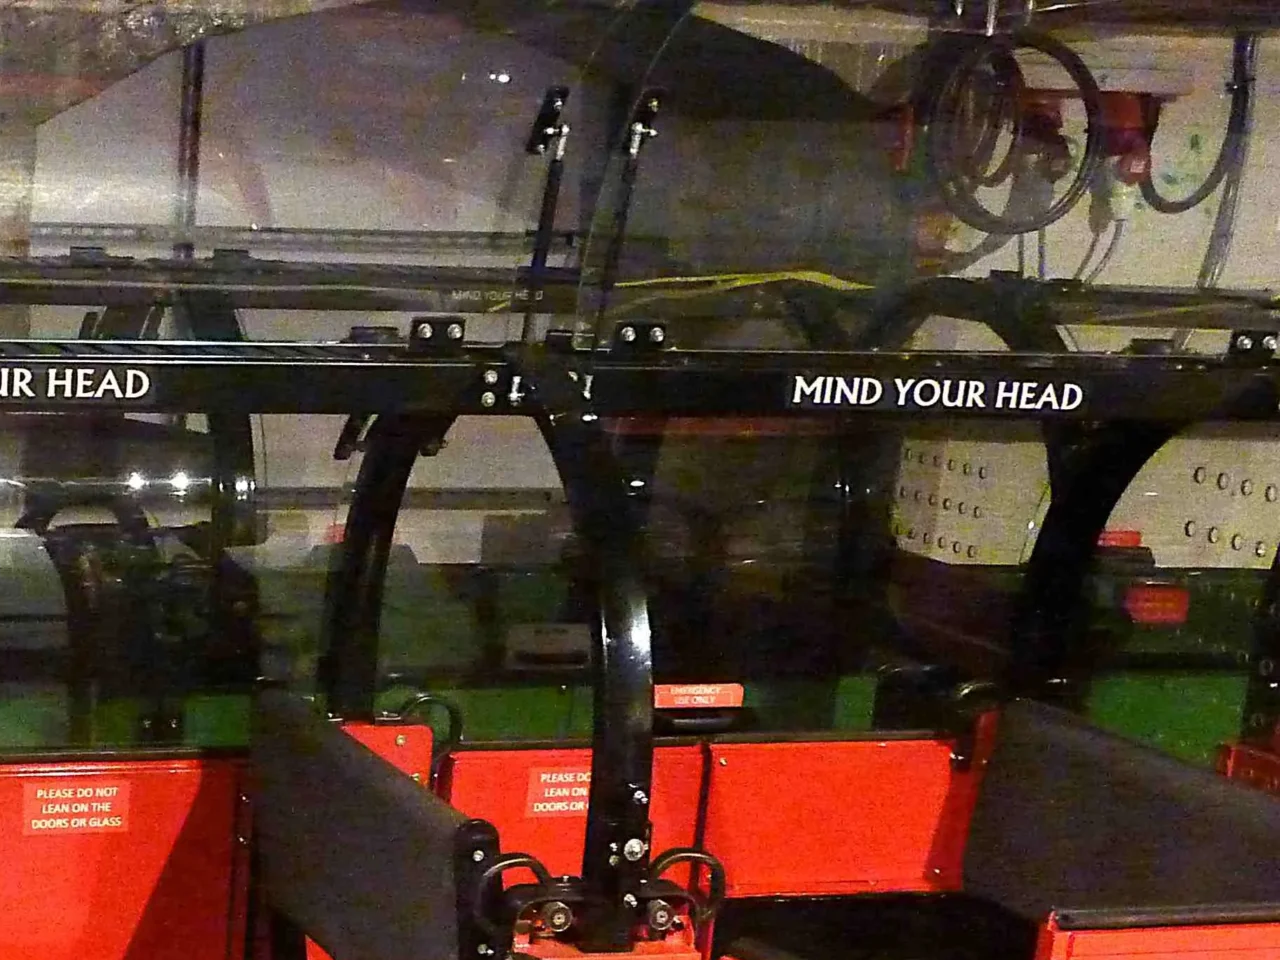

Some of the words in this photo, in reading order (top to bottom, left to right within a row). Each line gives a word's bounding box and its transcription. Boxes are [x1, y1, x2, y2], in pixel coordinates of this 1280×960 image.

[47, 368, 150, 398] HEAD
[792, 376, 882, 405] MIND
[894, 378, 986, 408] YOUR
[995, 381, 1083, 411] HEAD
[541, 772, 575, 783] PLEASE
[36, 788, 74, 799] PLEASE
[77, 788, 93, 798] DO
[95, 786, 118, 797] NOT
[544, 787, 570, 798] LEAN
[572, 787, 587, 797] ON
[42, 803, 70, 814] LEAN
[72, 803, 89, 813] ON
[91, 802, 112, 812] THE
[533, 801, 569, 813] DOORS
[569, 801, 585, 811] OR
[31, 818, 69, 830] DOORS
[71, 818, 87, 828] OR
[89, 816, 122, 827] GLASS
